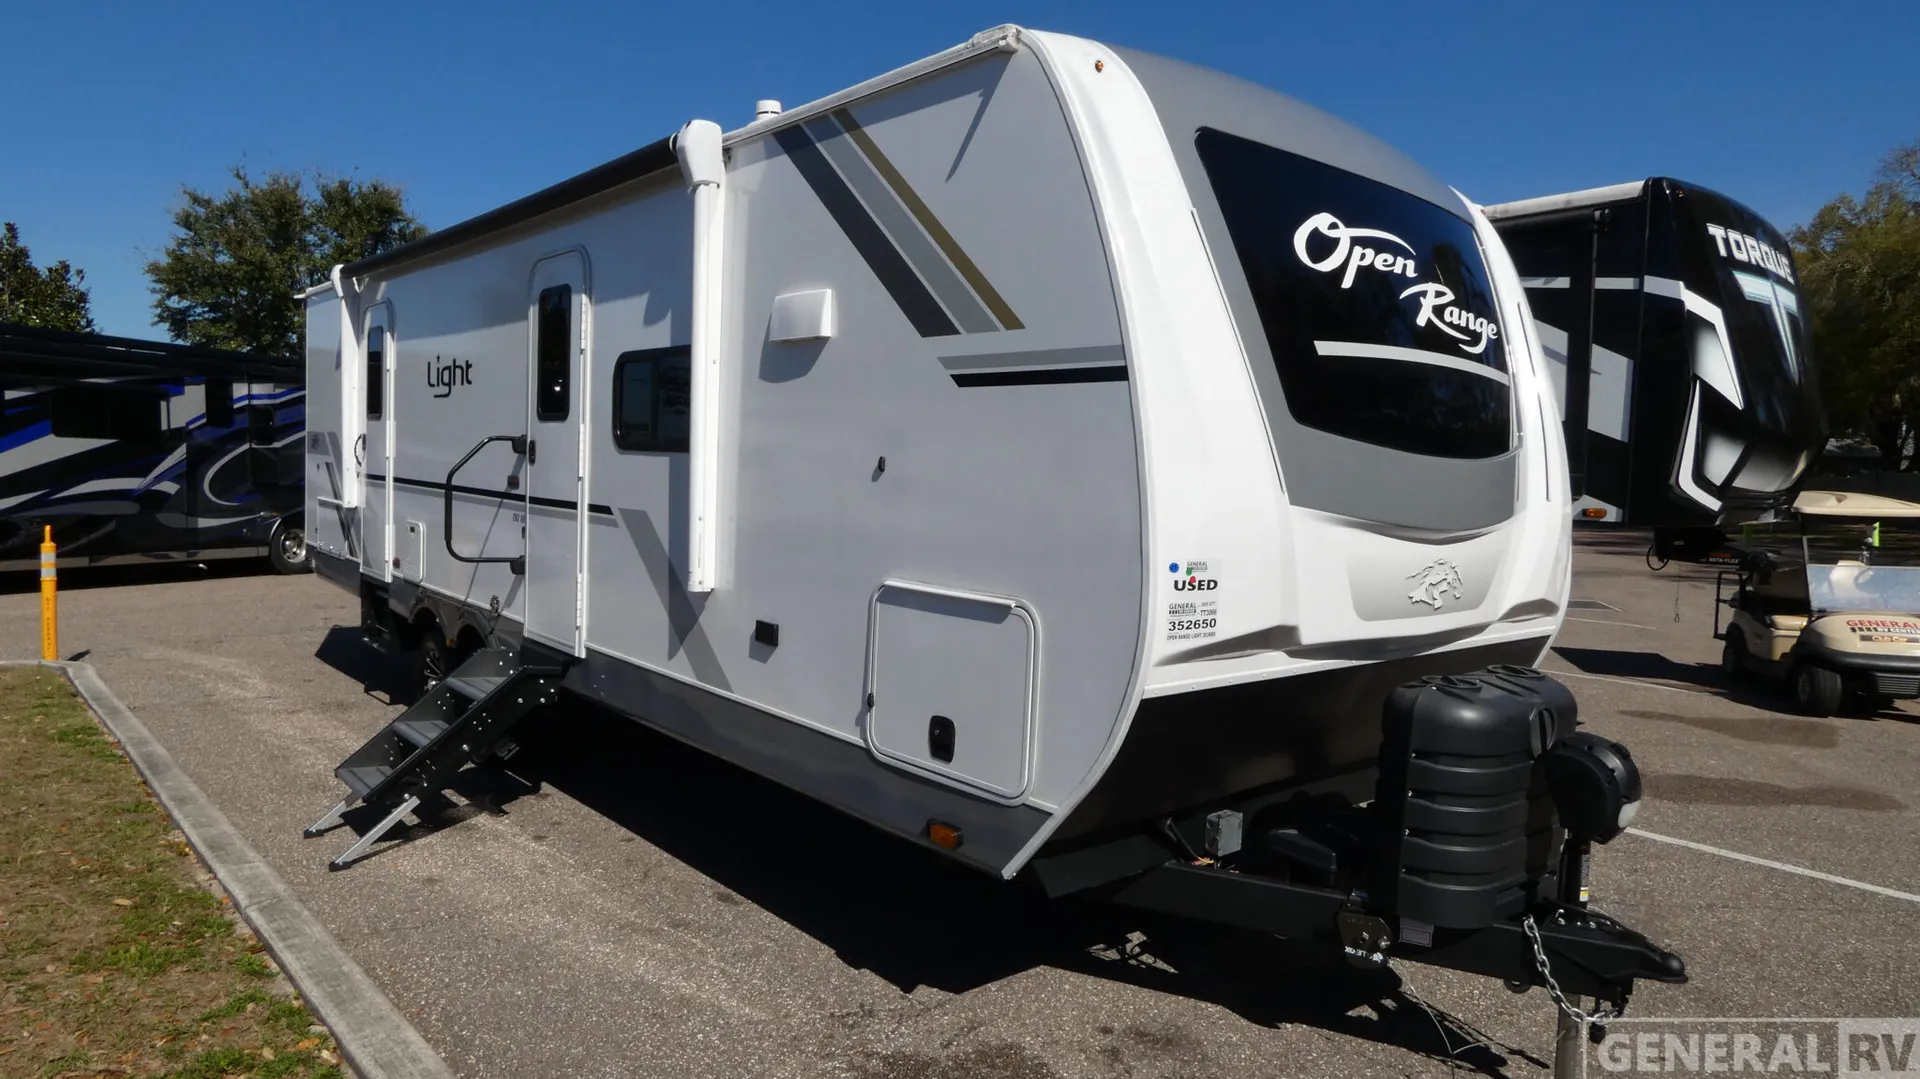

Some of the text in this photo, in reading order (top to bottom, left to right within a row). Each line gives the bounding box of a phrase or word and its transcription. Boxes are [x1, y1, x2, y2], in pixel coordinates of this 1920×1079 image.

[1294, 212, 1418, 289] Open
[1706, 223, 1795, 285] TORQUE
[1400, 282, 1499, 354] Range
[427, 352, 473, 399] Light
[1173, 579, 1218, 591] USED
[1168, 618, 1217, 632] 352650
[1846, 620, 1920, 629] GENERAL
